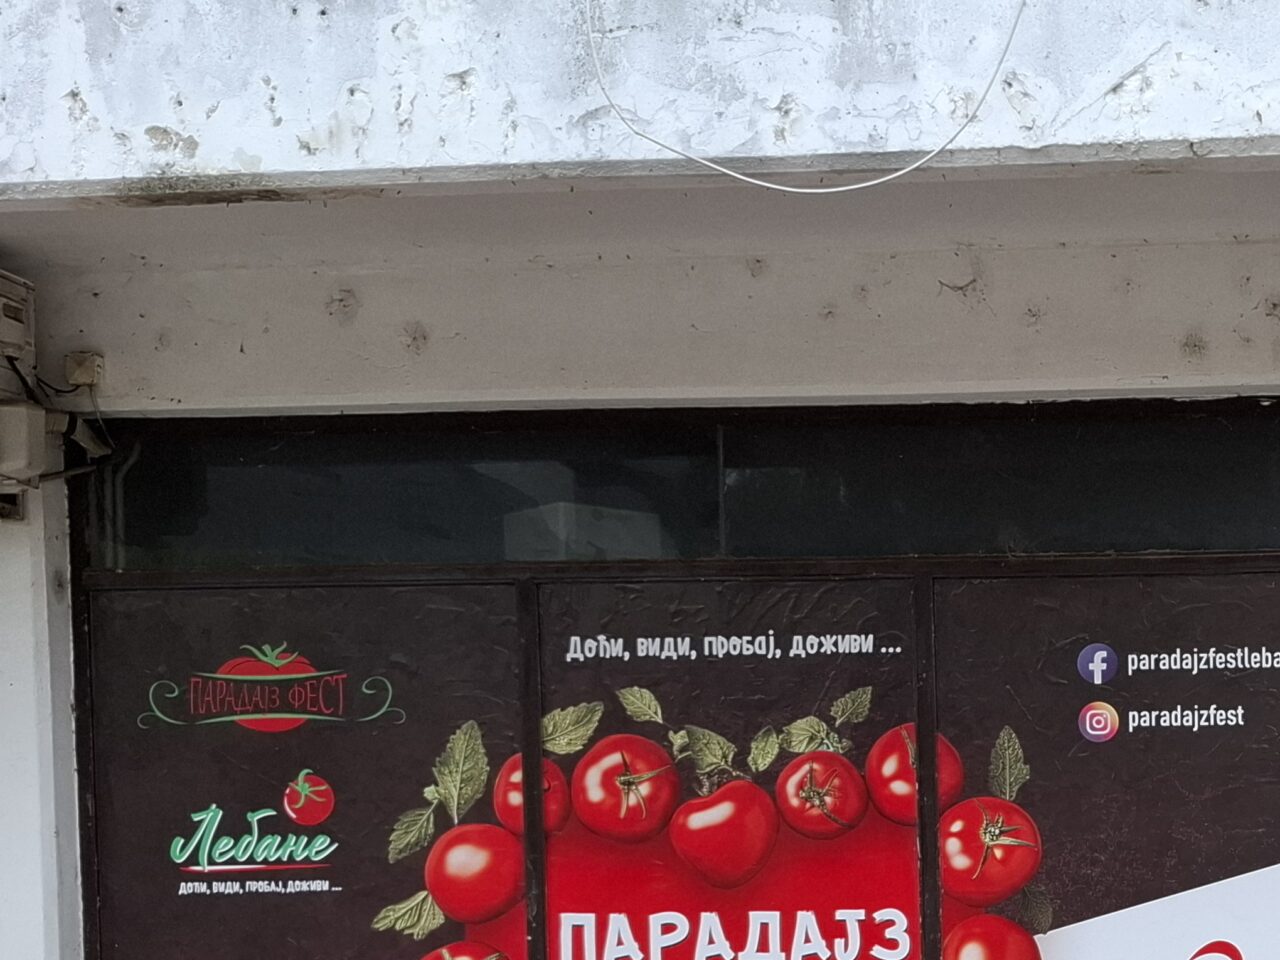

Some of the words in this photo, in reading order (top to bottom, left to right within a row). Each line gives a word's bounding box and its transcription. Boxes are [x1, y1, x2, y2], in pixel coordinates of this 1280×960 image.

[637, 636, 697, 660] види,
[789, 634, 874, 659] доживи
[188, 676, 281, 715] ПАРАДАЈЗ
[288, 674, 348, 715] ФЕСТ
[1128, 704, 1245, 733] paradajzfest
[170, 803, 339, 872] Лебане
